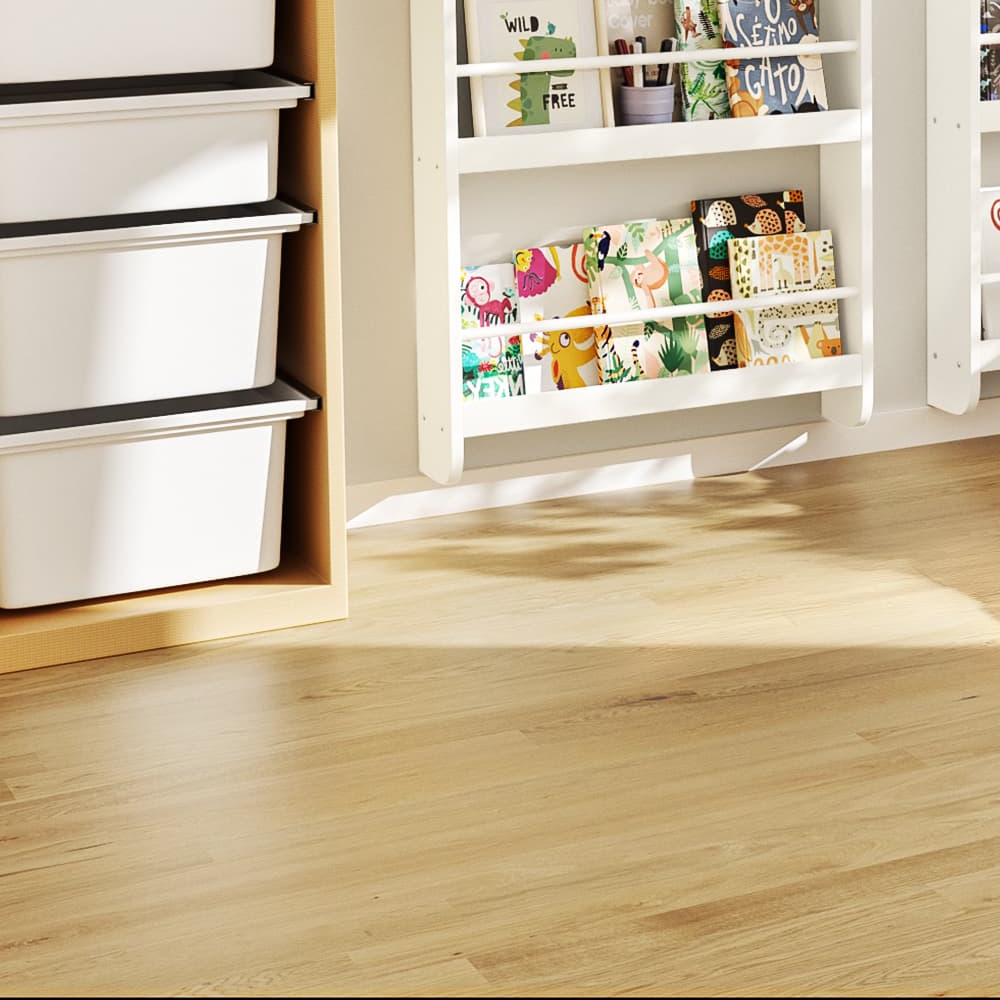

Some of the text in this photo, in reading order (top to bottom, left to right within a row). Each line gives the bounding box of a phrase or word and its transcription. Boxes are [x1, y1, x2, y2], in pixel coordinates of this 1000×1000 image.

[504, 15, 540, 33] WILD
[744, 56, 801, 106] GATO
[542, 93, 576, 111] FREE
